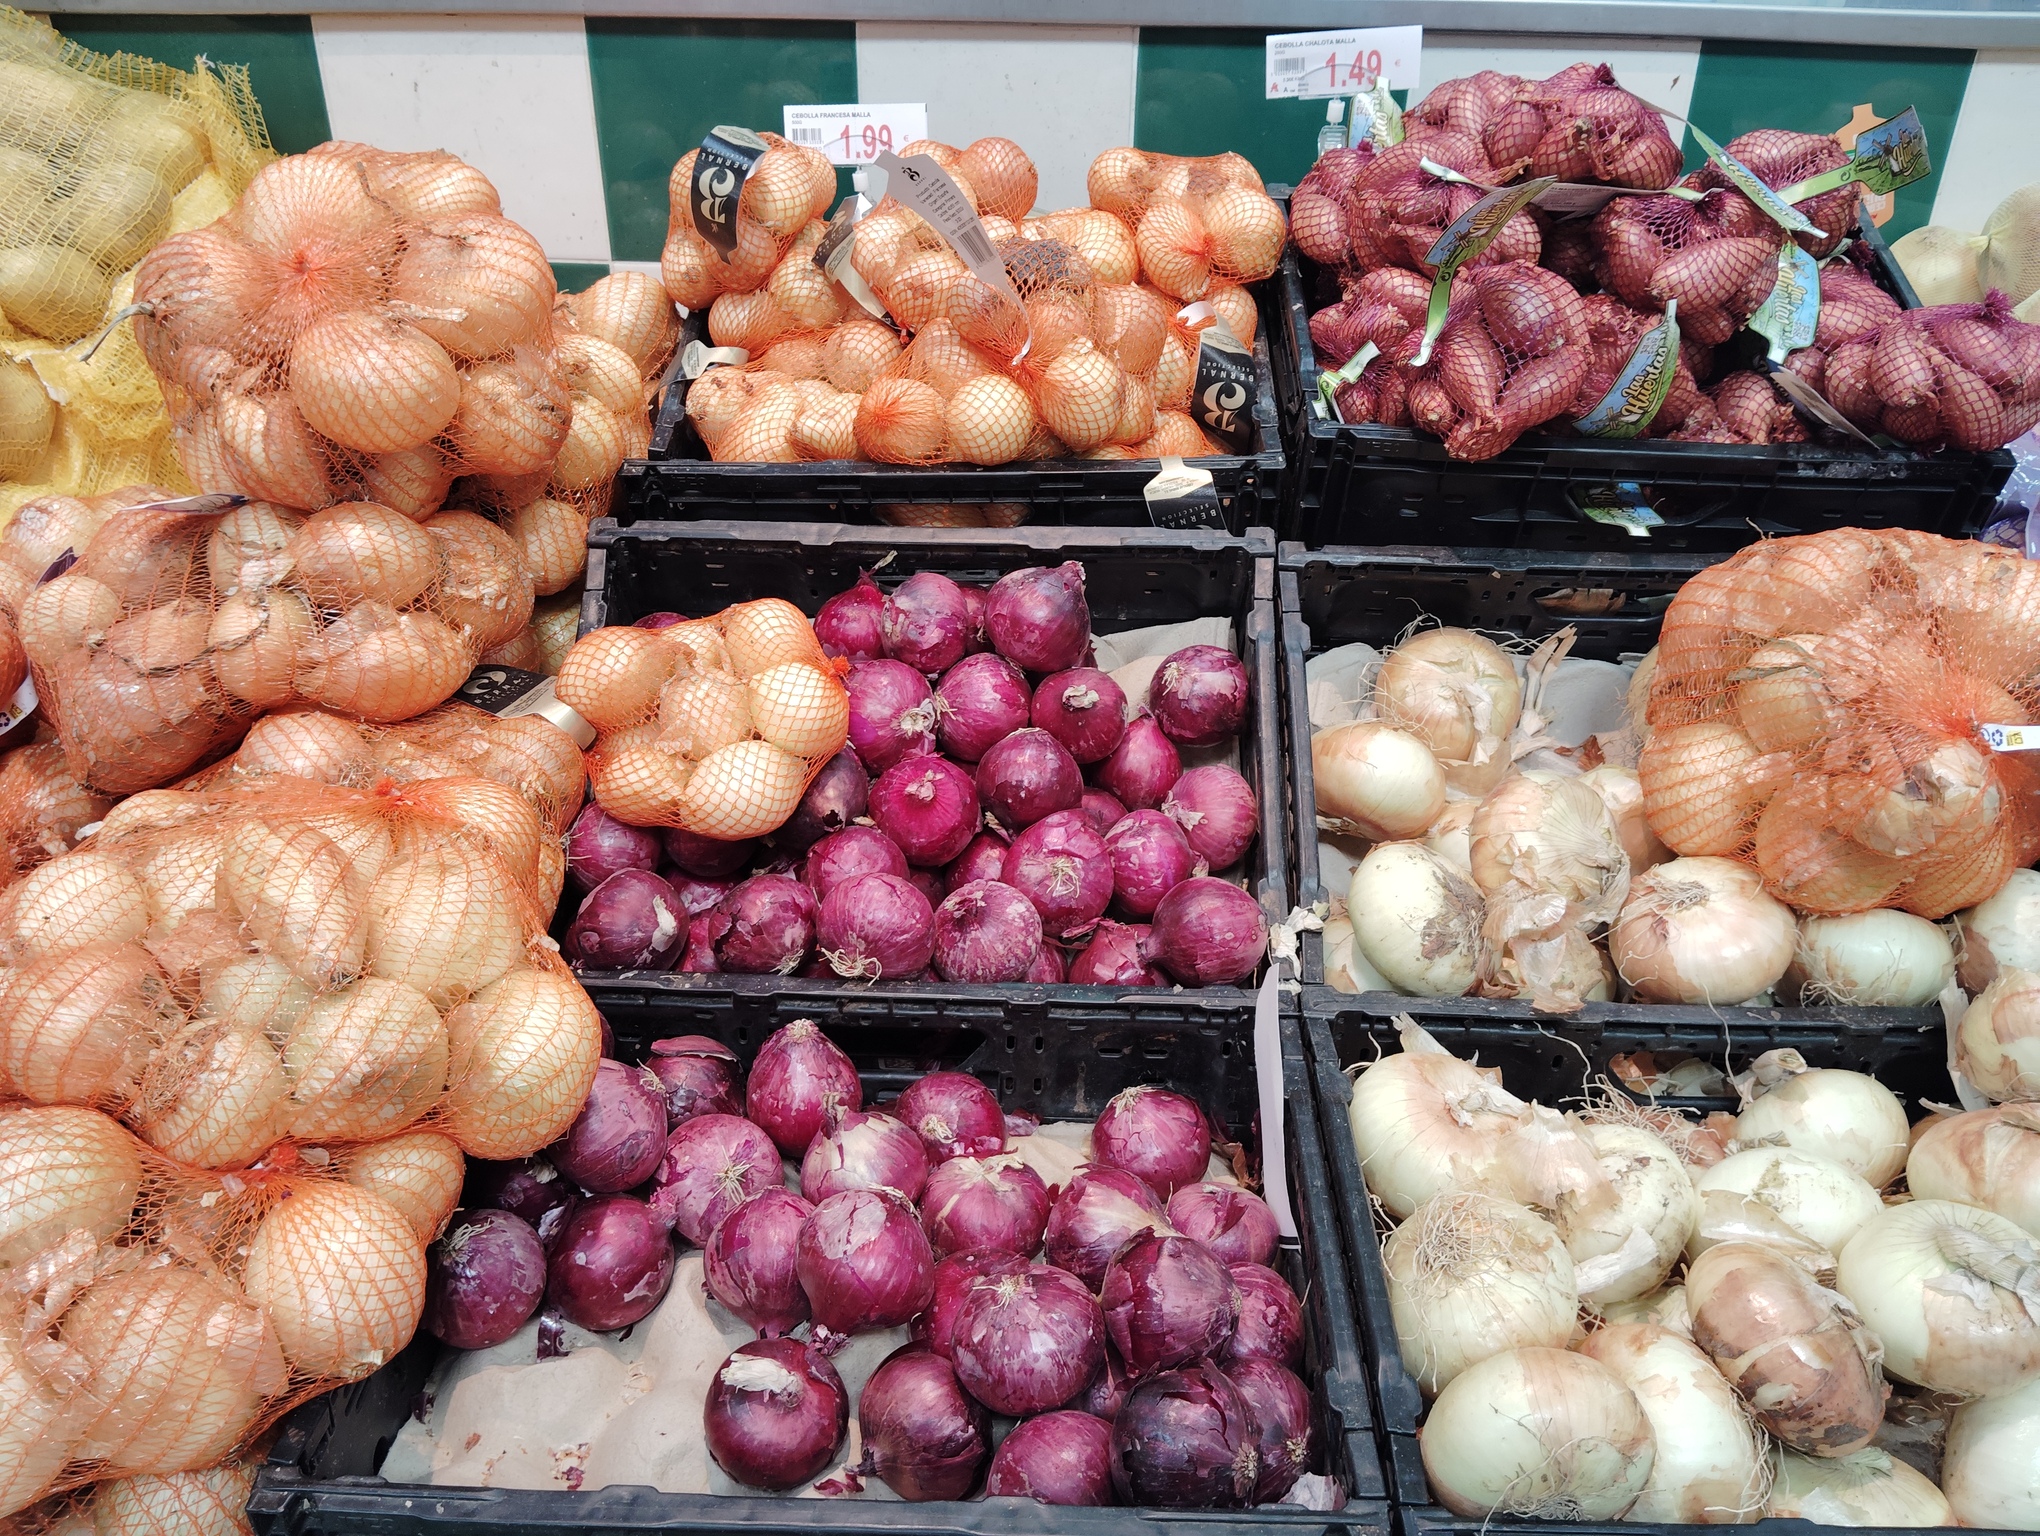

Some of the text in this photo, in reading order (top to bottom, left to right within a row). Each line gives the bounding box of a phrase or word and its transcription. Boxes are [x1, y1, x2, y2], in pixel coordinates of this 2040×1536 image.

[1274, 37, 1356, 49] CEBOLLA CHALOTA MALLA
[1325, 49, 1382, 88] 1.49
[819, 111, 851, 119] FRANCESA
[840, 124, 894, 160] 1.99
[701, 152, 749, 171] BERNAL
[1201, 368, 1254, 383] BERNAL
[1620, 346, 1668, 417] Huertas
[1621, 374, 1645, 398] Las
[1162, 503, 1209, 521] SELECTION
